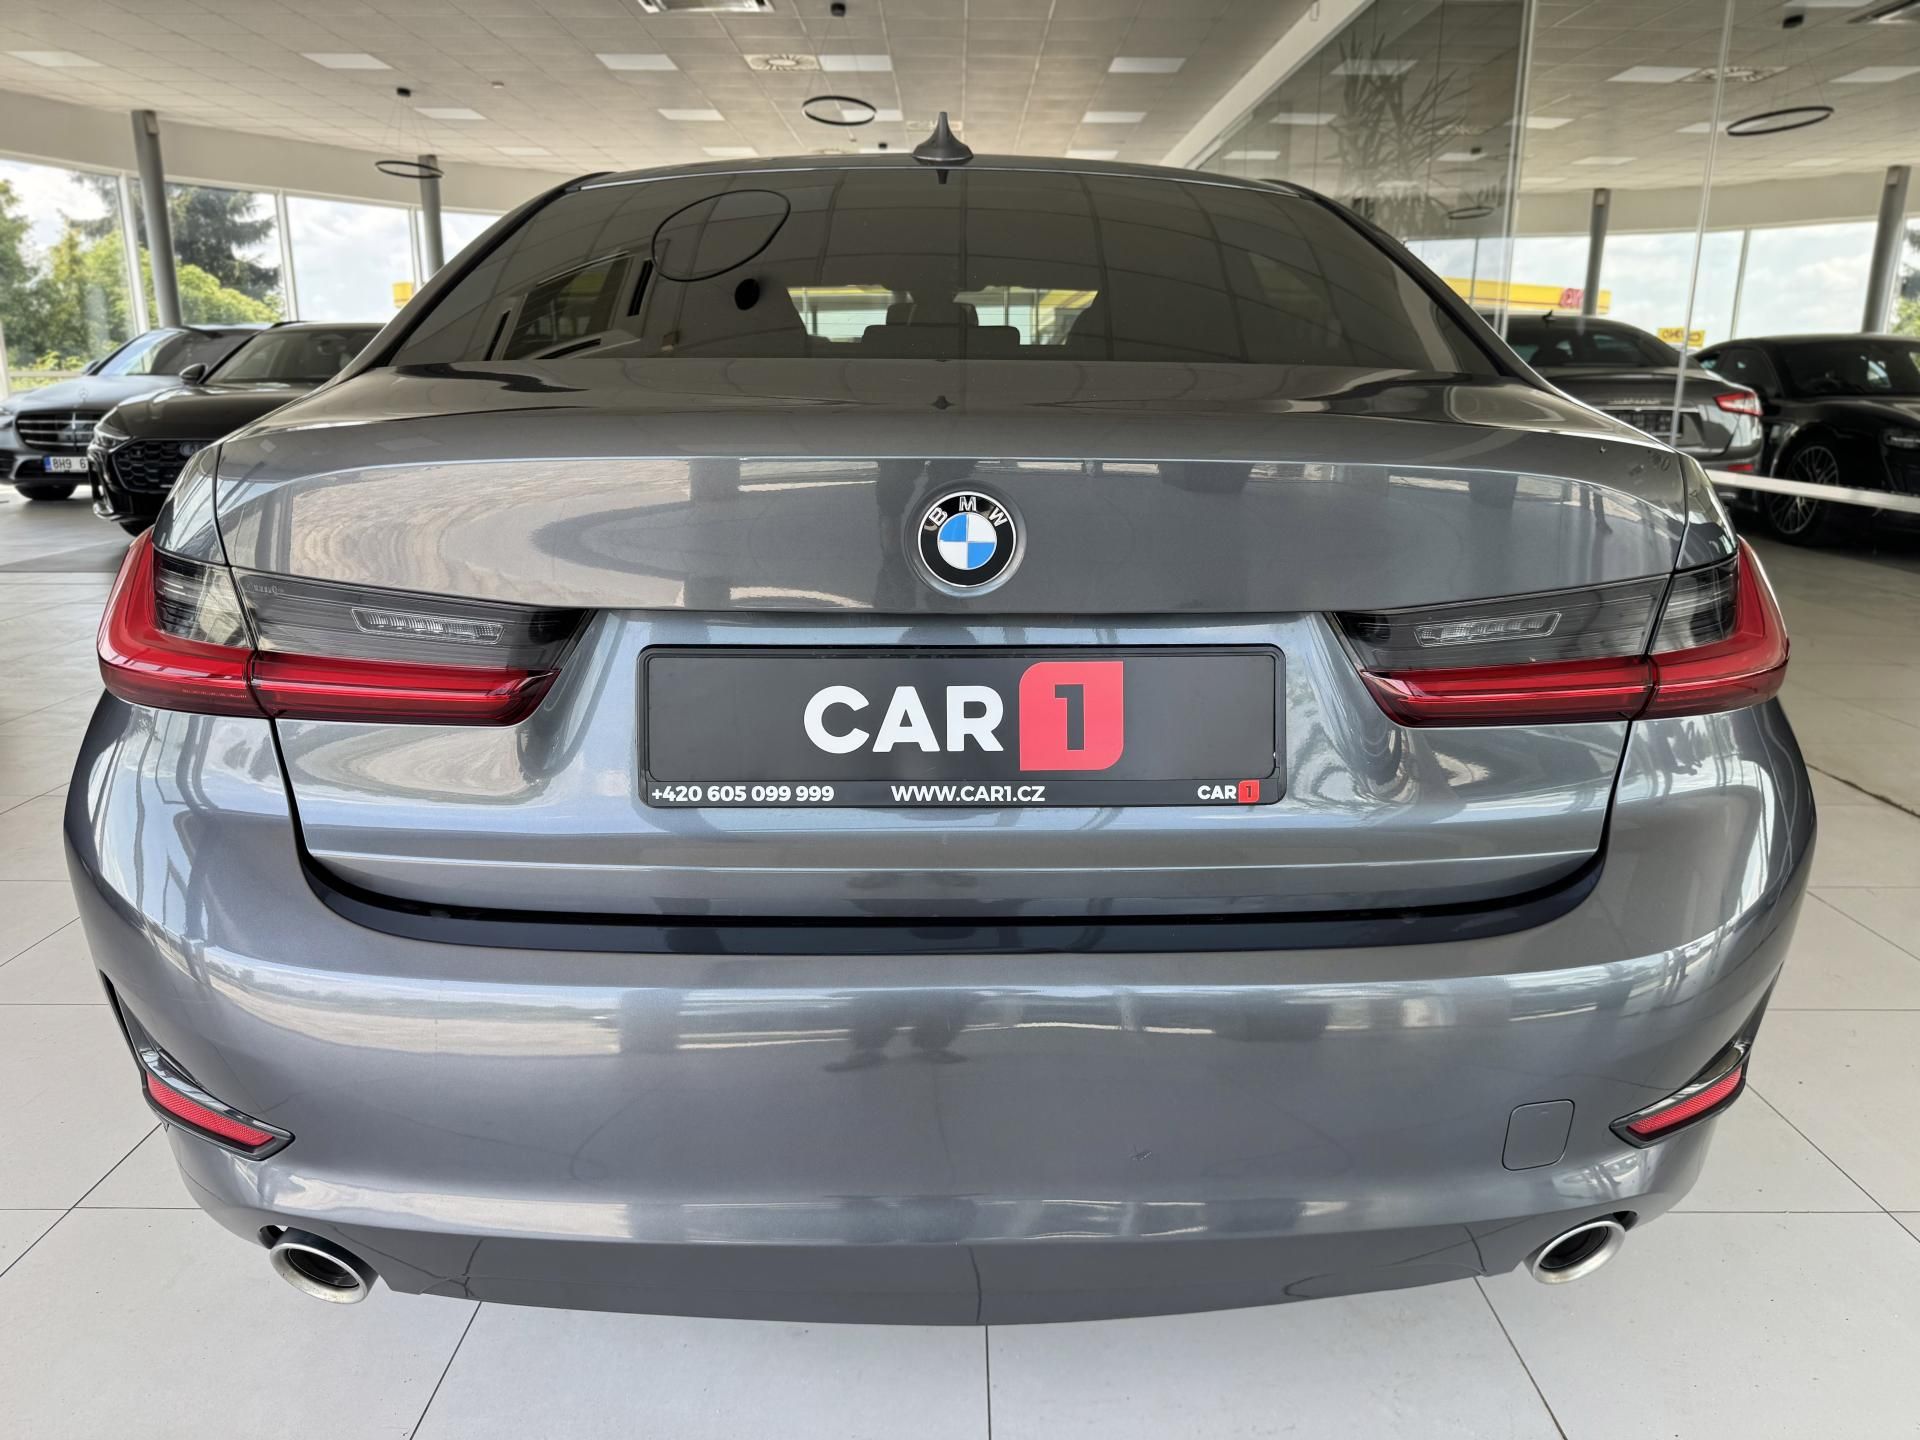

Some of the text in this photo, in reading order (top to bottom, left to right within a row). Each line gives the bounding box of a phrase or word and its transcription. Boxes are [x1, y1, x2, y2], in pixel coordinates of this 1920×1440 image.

[928, 496, 1008, 527] BMW
[803, 685, 1004, 754] CAR
[651, 785, 835, 802] +420 605 099 999
[890, 785, 1046, 802] WWW.CAR1.CZ
[1197, 785, 1237, 800] CAR
